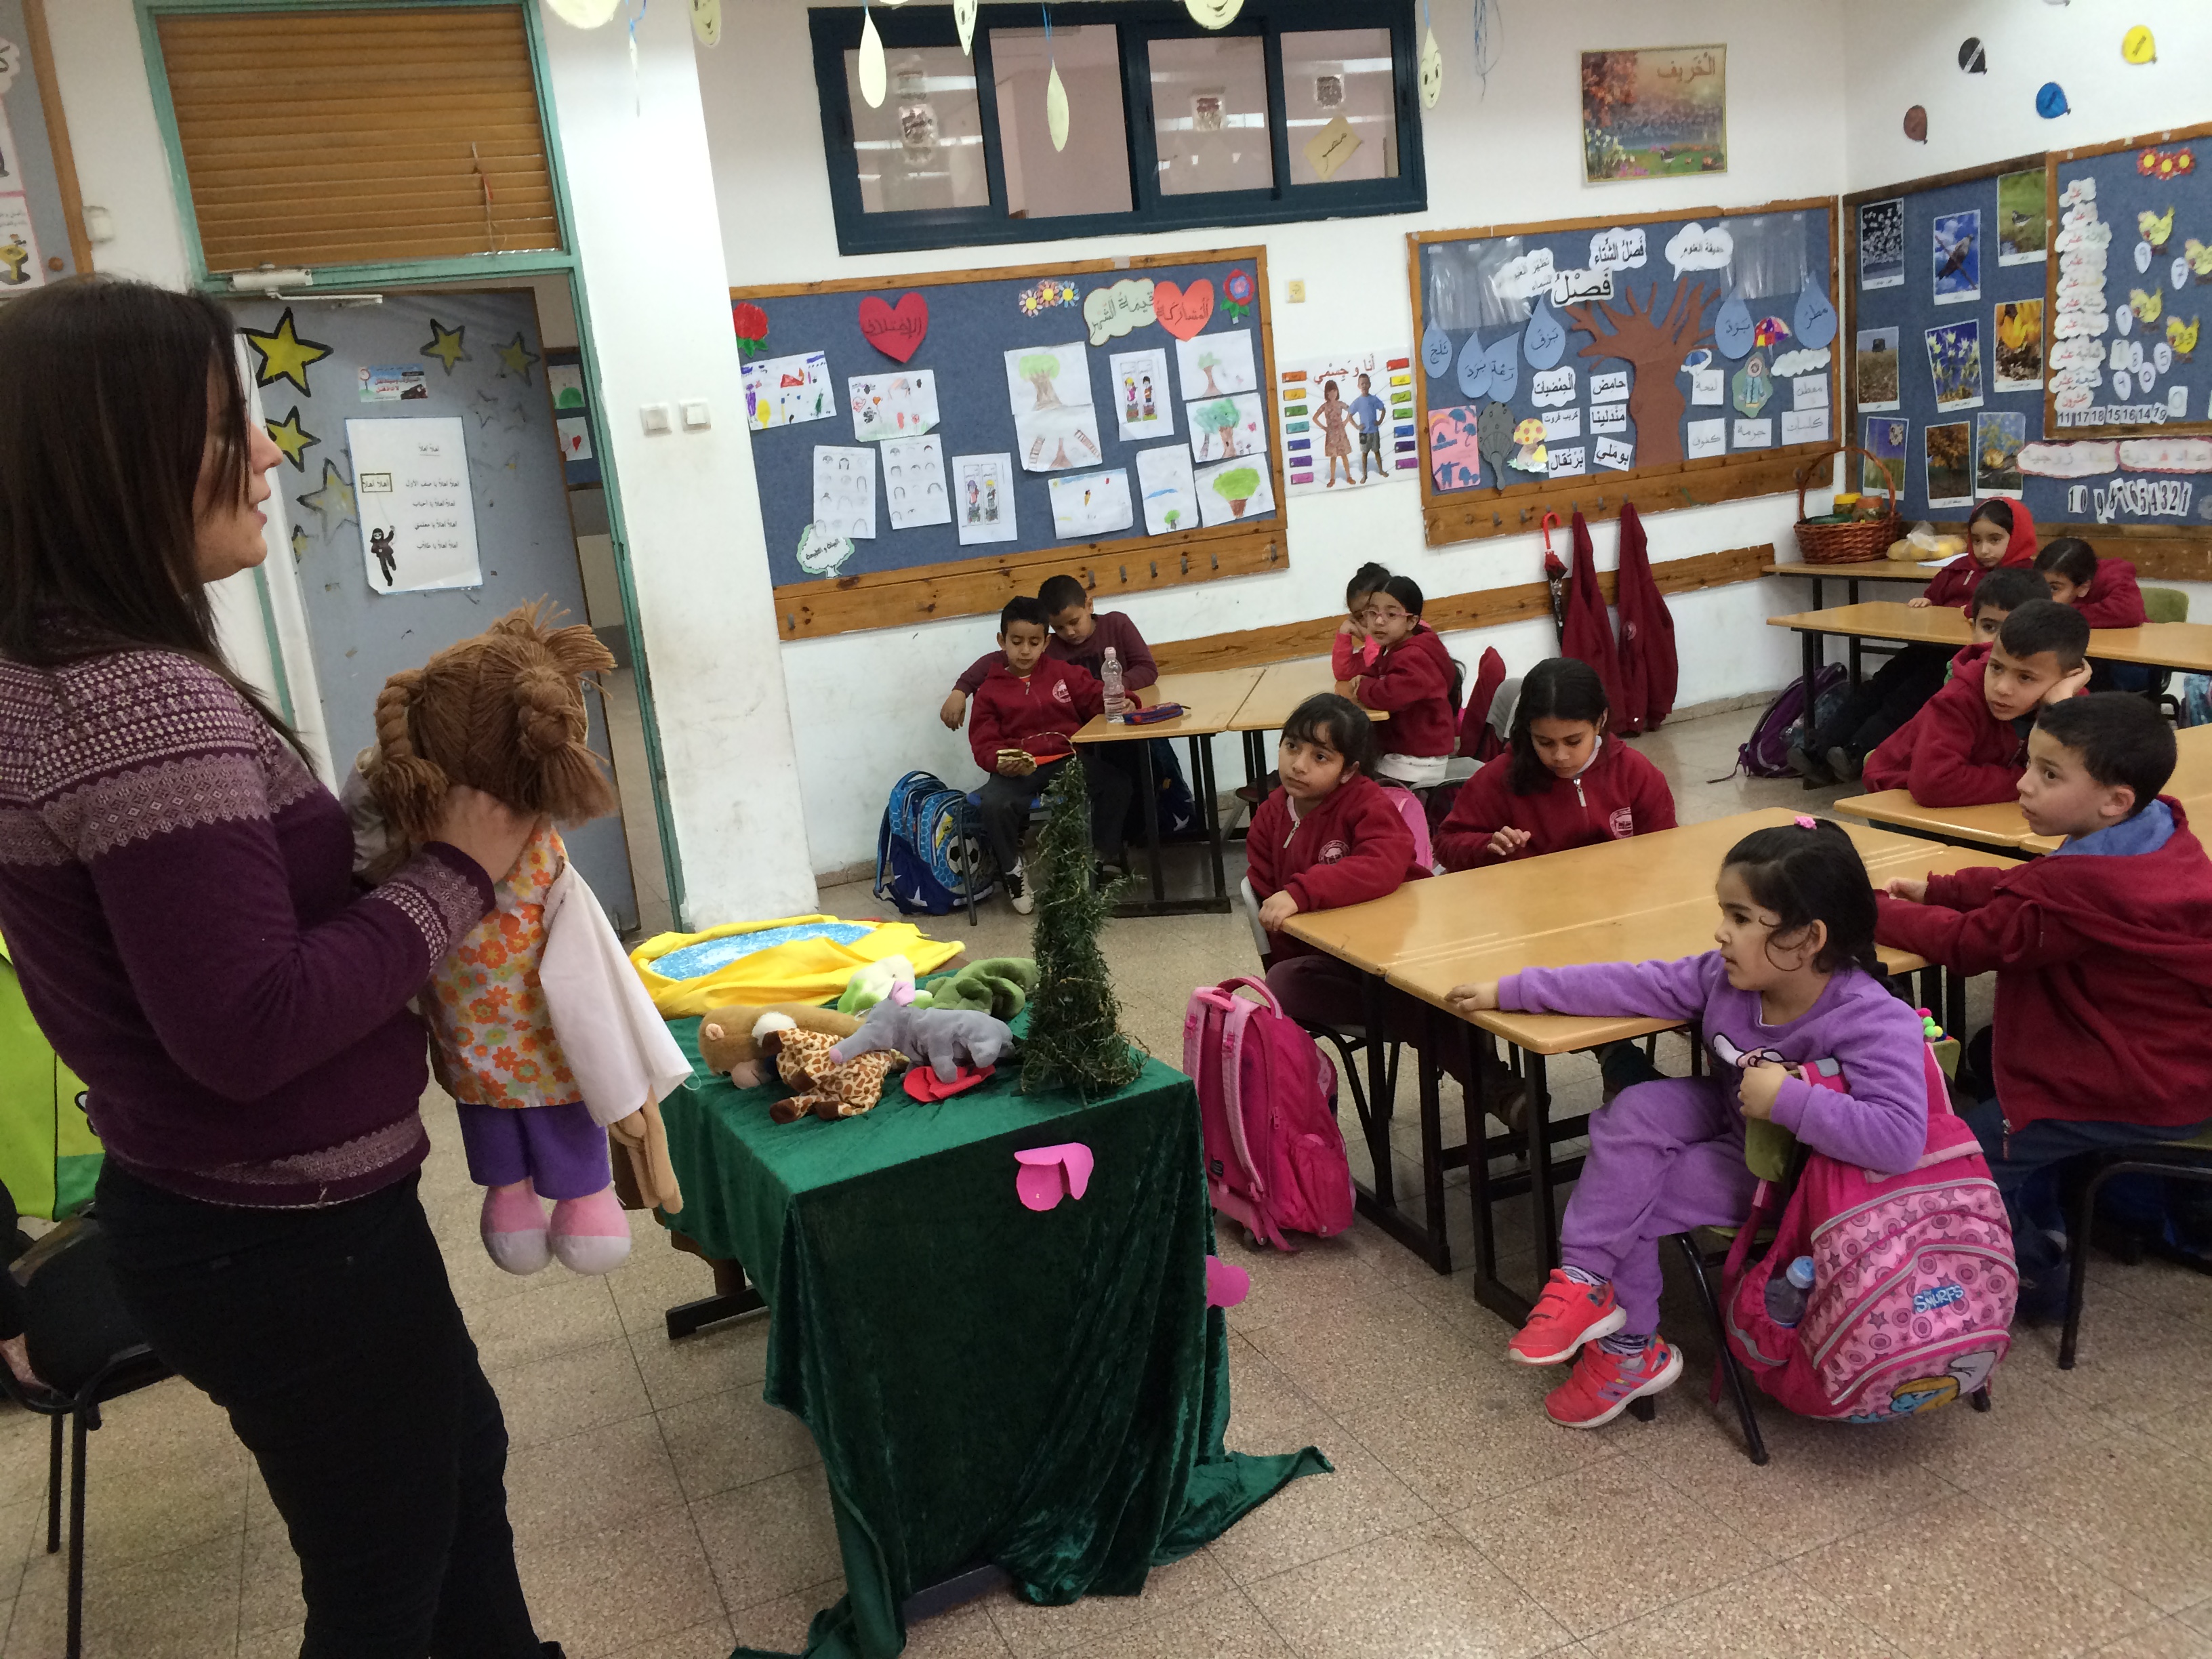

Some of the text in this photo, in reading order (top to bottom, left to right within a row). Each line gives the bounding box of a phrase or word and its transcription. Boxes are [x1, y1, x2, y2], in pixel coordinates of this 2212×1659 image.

[2076, 411, 2089, 423] 17
[2092, 409, 2106, 422] 18
[2108, 408, 2121, 422] 15
[2123, 408, 2135, 421] 16
[2137, 407, 2151, 419] 14
[2069, 489, 2087, 512] 10
[2097, 491, 2104, 516] 9
[2139, 487, 2147, 512] 5
[2150, 488, 2158, 512] 4
[2162, 485, 2169, 510] 3
[2169, 485, 2179, 510] 2
[2181, 489, 2189, 512] 1
[1914, 1285, 1964, 1313] SMURFS
